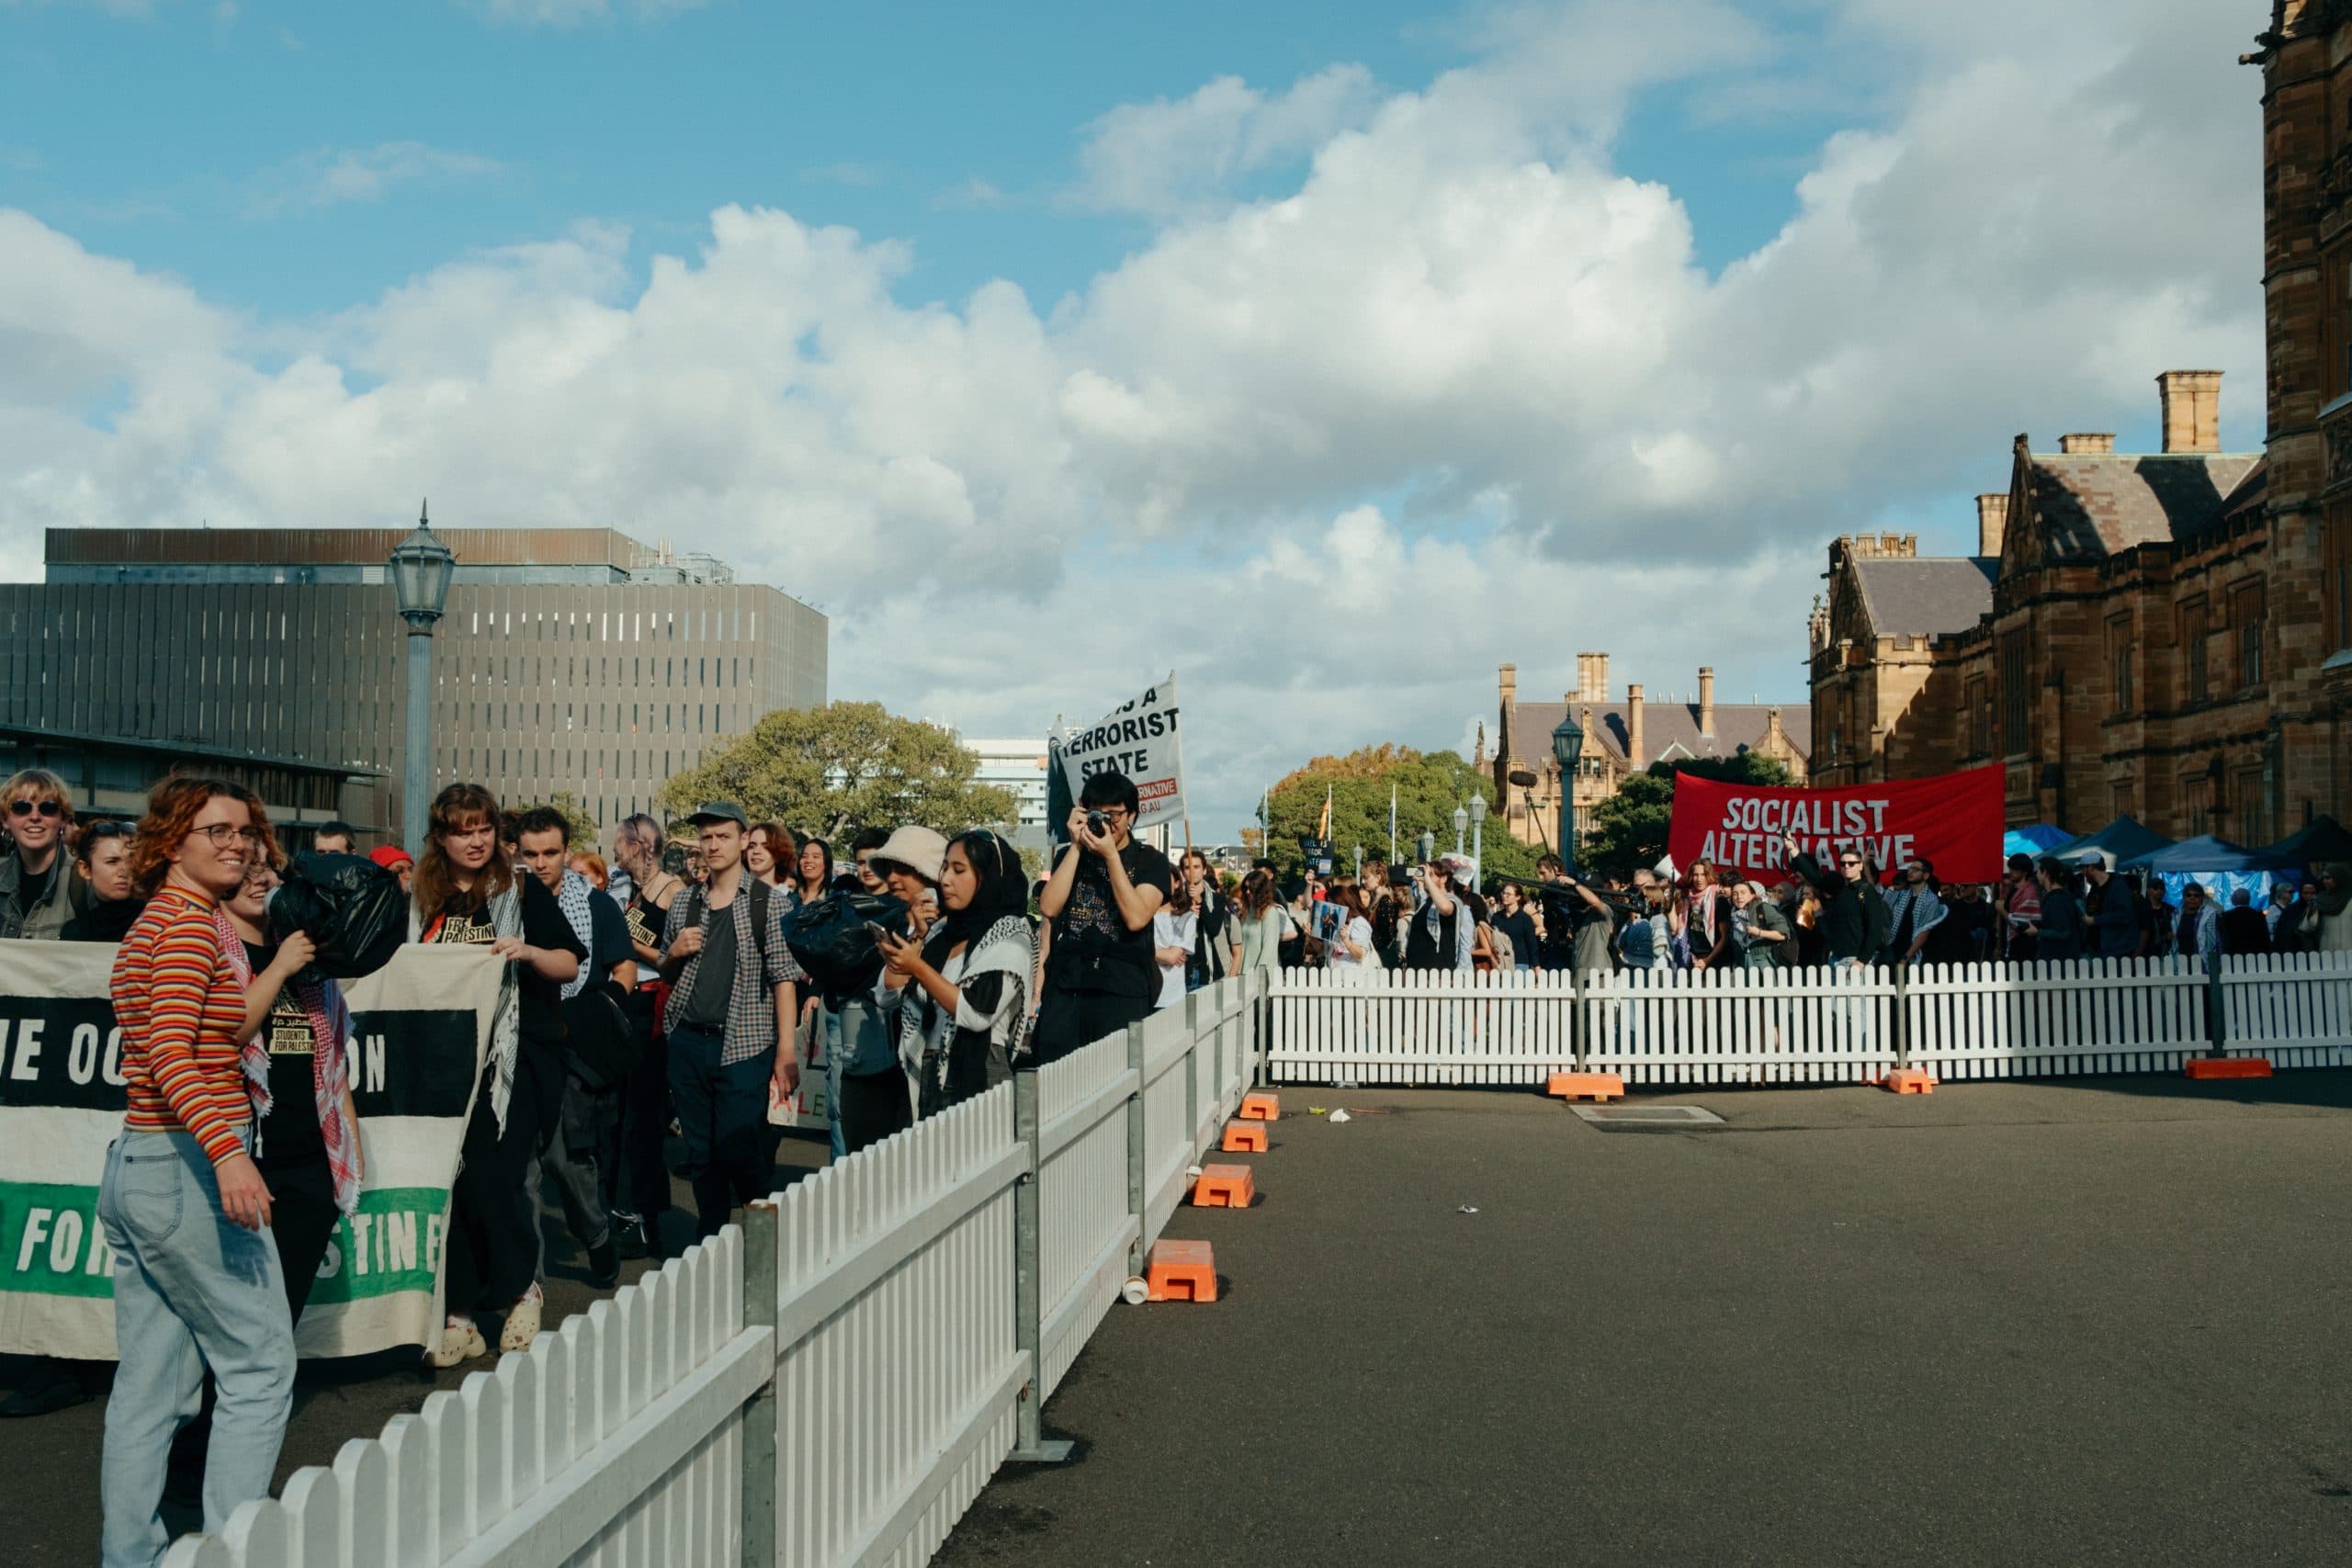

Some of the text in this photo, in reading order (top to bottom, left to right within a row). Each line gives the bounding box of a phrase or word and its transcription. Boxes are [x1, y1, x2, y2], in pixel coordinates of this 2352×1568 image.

[1064, 707, 1179, 758] TERRORIST
[1081, 749, 1148, 782] STATE
[1138, 781, 1175, 798] RNATIVE
[1723, 797, 1890, 836] SOCIALIST
[445, 924, 497, 943] PALESTIN
[275, 1042, 288, 1052] FOR
[276, 1030, 306, 1041] STUDENTS
[347, 1034, 385, 1093] ON
[316, 1211, 441, 1279] STINE
